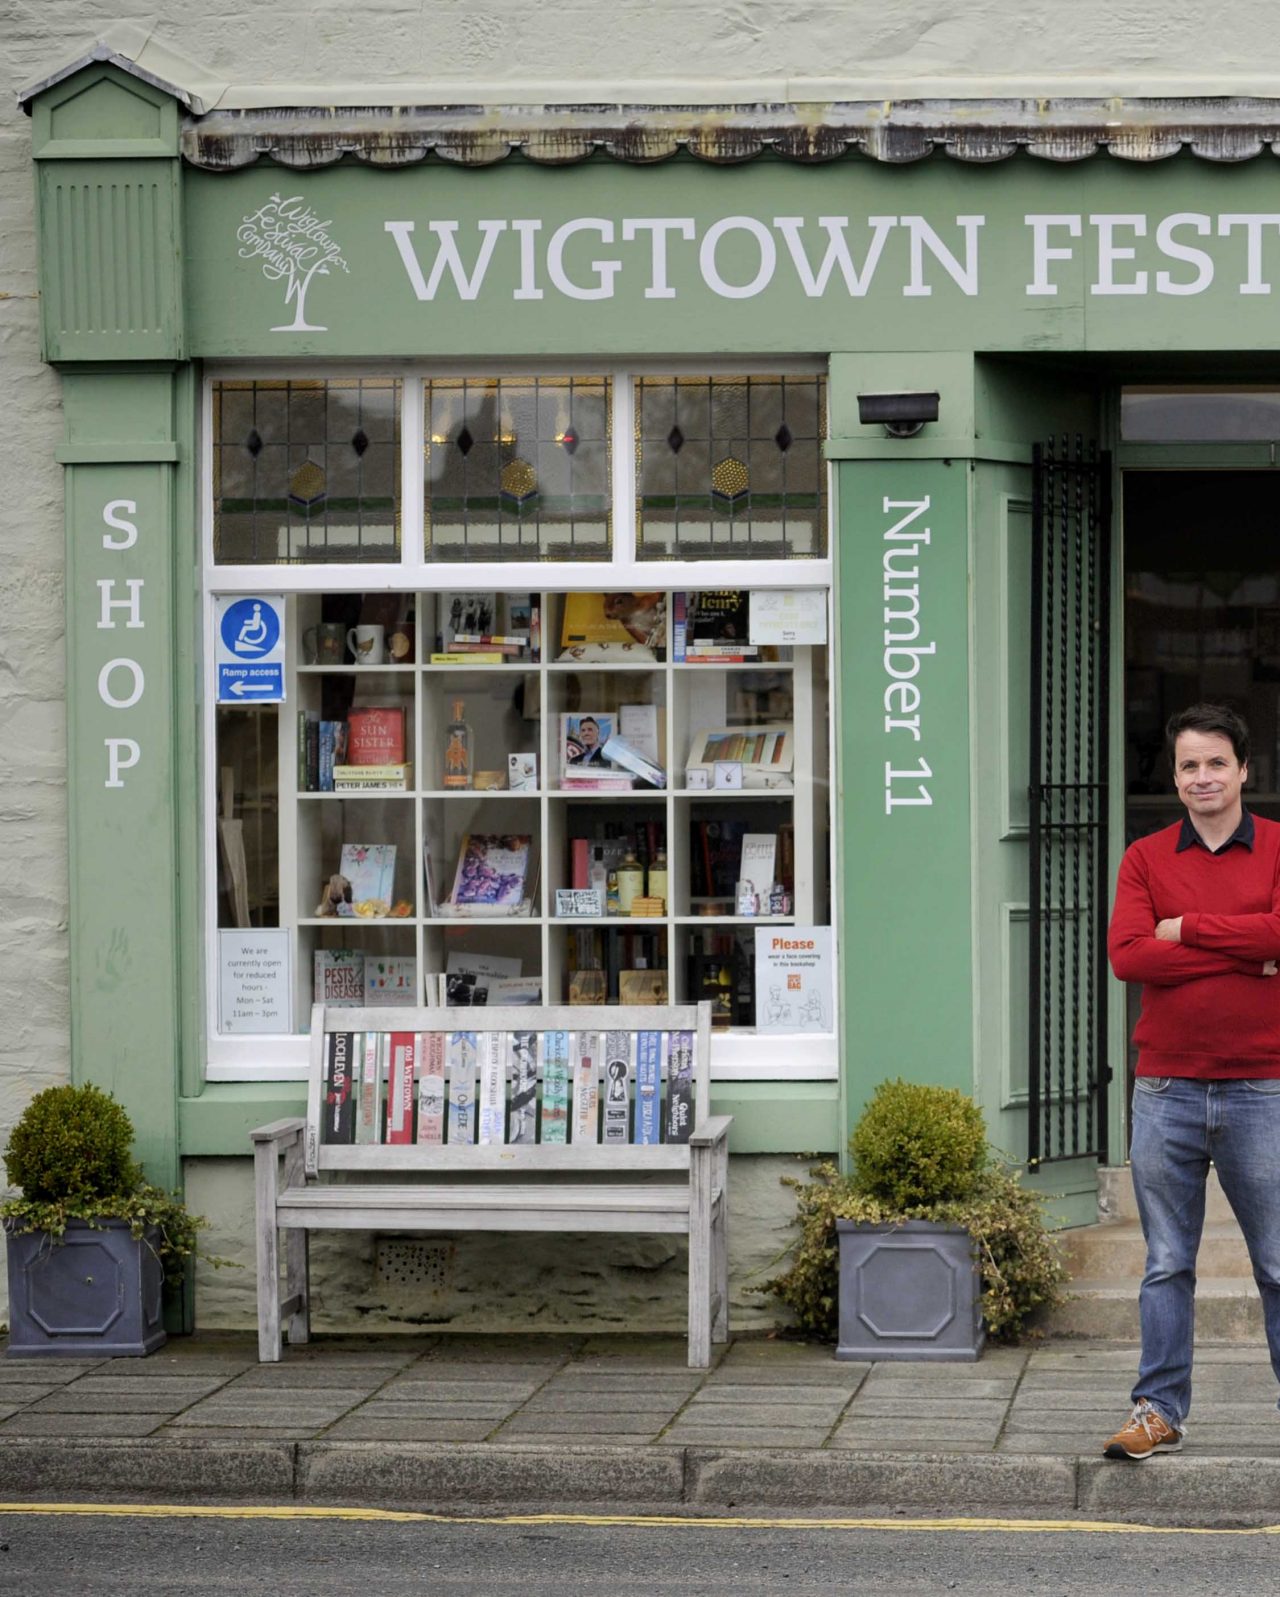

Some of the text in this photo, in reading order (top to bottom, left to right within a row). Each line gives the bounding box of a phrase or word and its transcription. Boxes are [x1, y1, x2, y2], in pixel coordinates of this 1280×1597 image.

[384, 215, 985, 300] WIGTOWN
[96, 499, 145, 787] SHOP
[883, 495, 936, 815] Number 11
[222, 669, 248, 678] Ramp
[361, 726, 388, 736] SUN
[354, 737, 395, 748] SISTER
[241, 947, 253, 955] We
[772, 938, 814, 950] Please
[227, 960, 260, 968] currently
[325, 968, 354, 985] PESTS
[325, 984, 364, 1000] DISEASES
[334, 1032, 347, 1088] LOCHLEVEN
[405, 1046, 413, 1061] Old
[671, 1094, 680, 1136] Neighbors
[679, 1102, 688, 1126] Quiet
